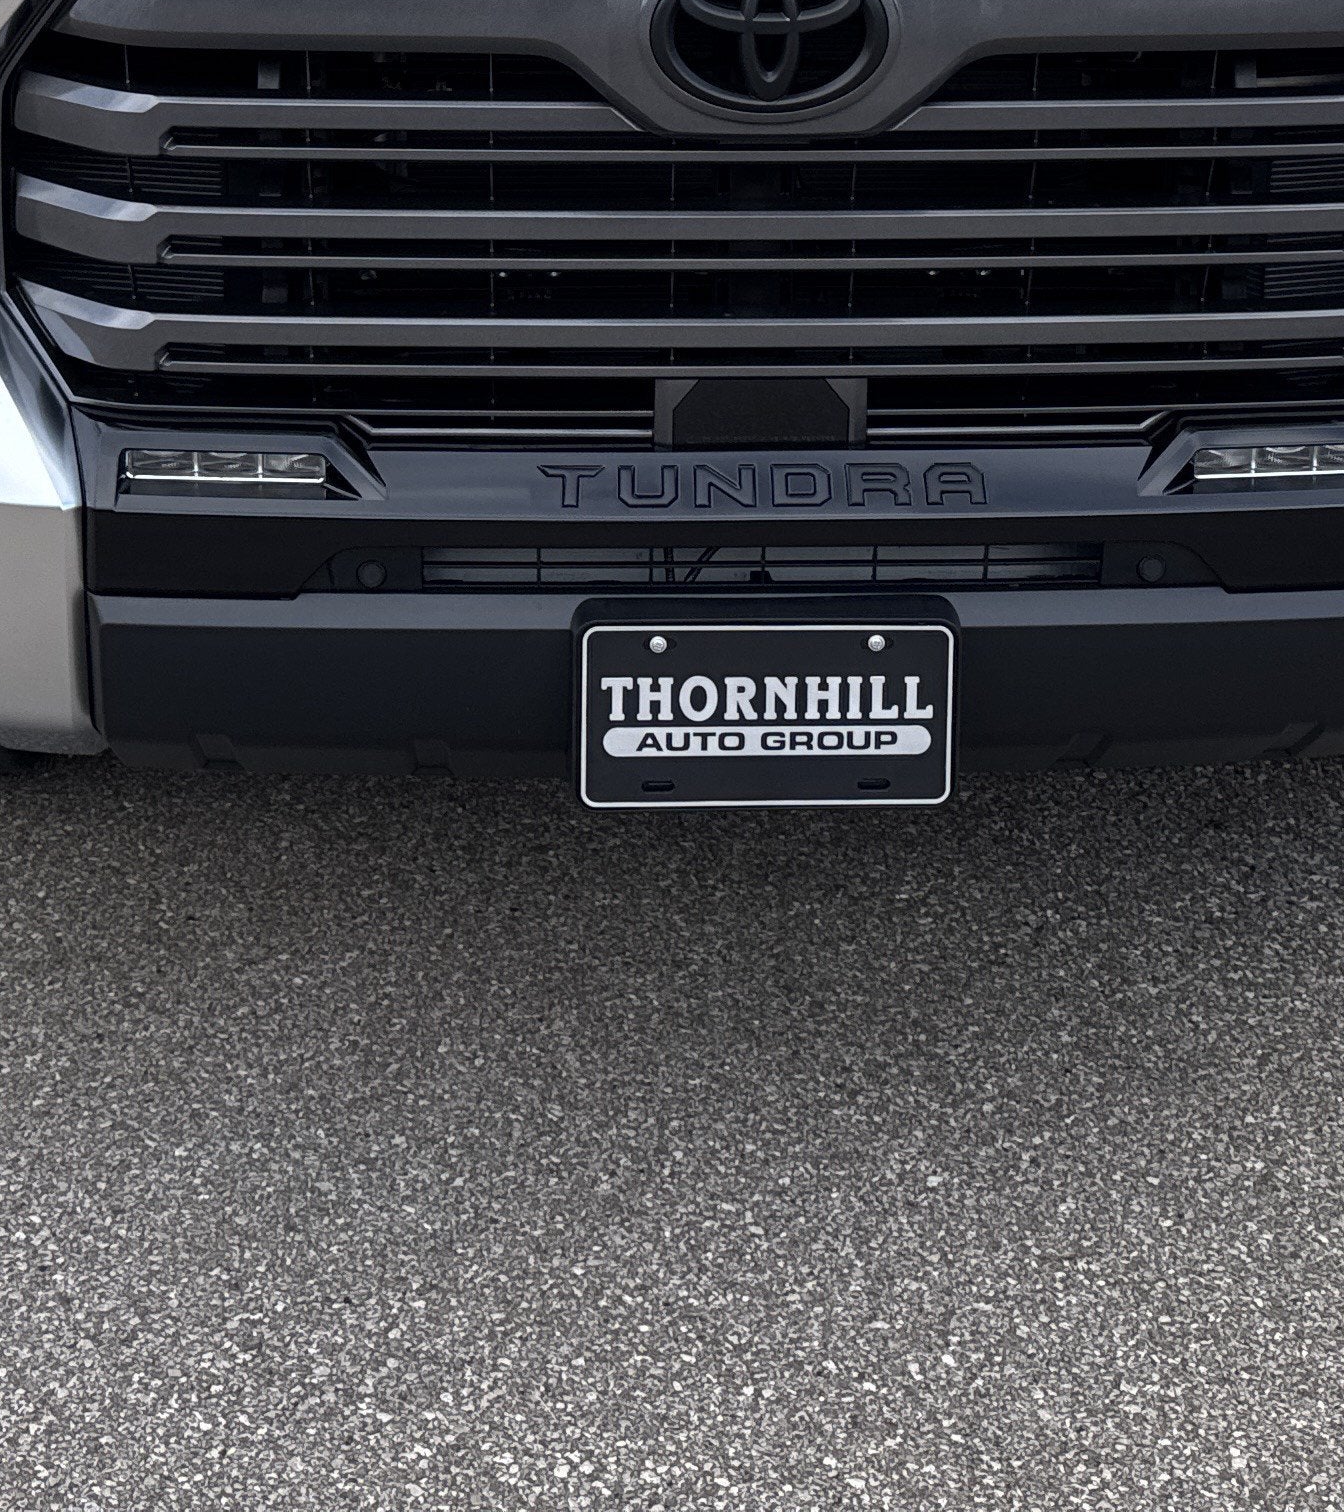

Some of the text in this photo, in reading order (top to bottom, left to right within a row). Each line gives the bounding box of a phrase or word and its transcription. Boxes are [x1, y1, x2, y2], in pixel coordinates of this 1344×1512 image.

[536, 463, 988, 509] TUNDRA
[601, 675, 934, 722] THORNHILL
[636, 730, 898, 752] AUTO GROUP
